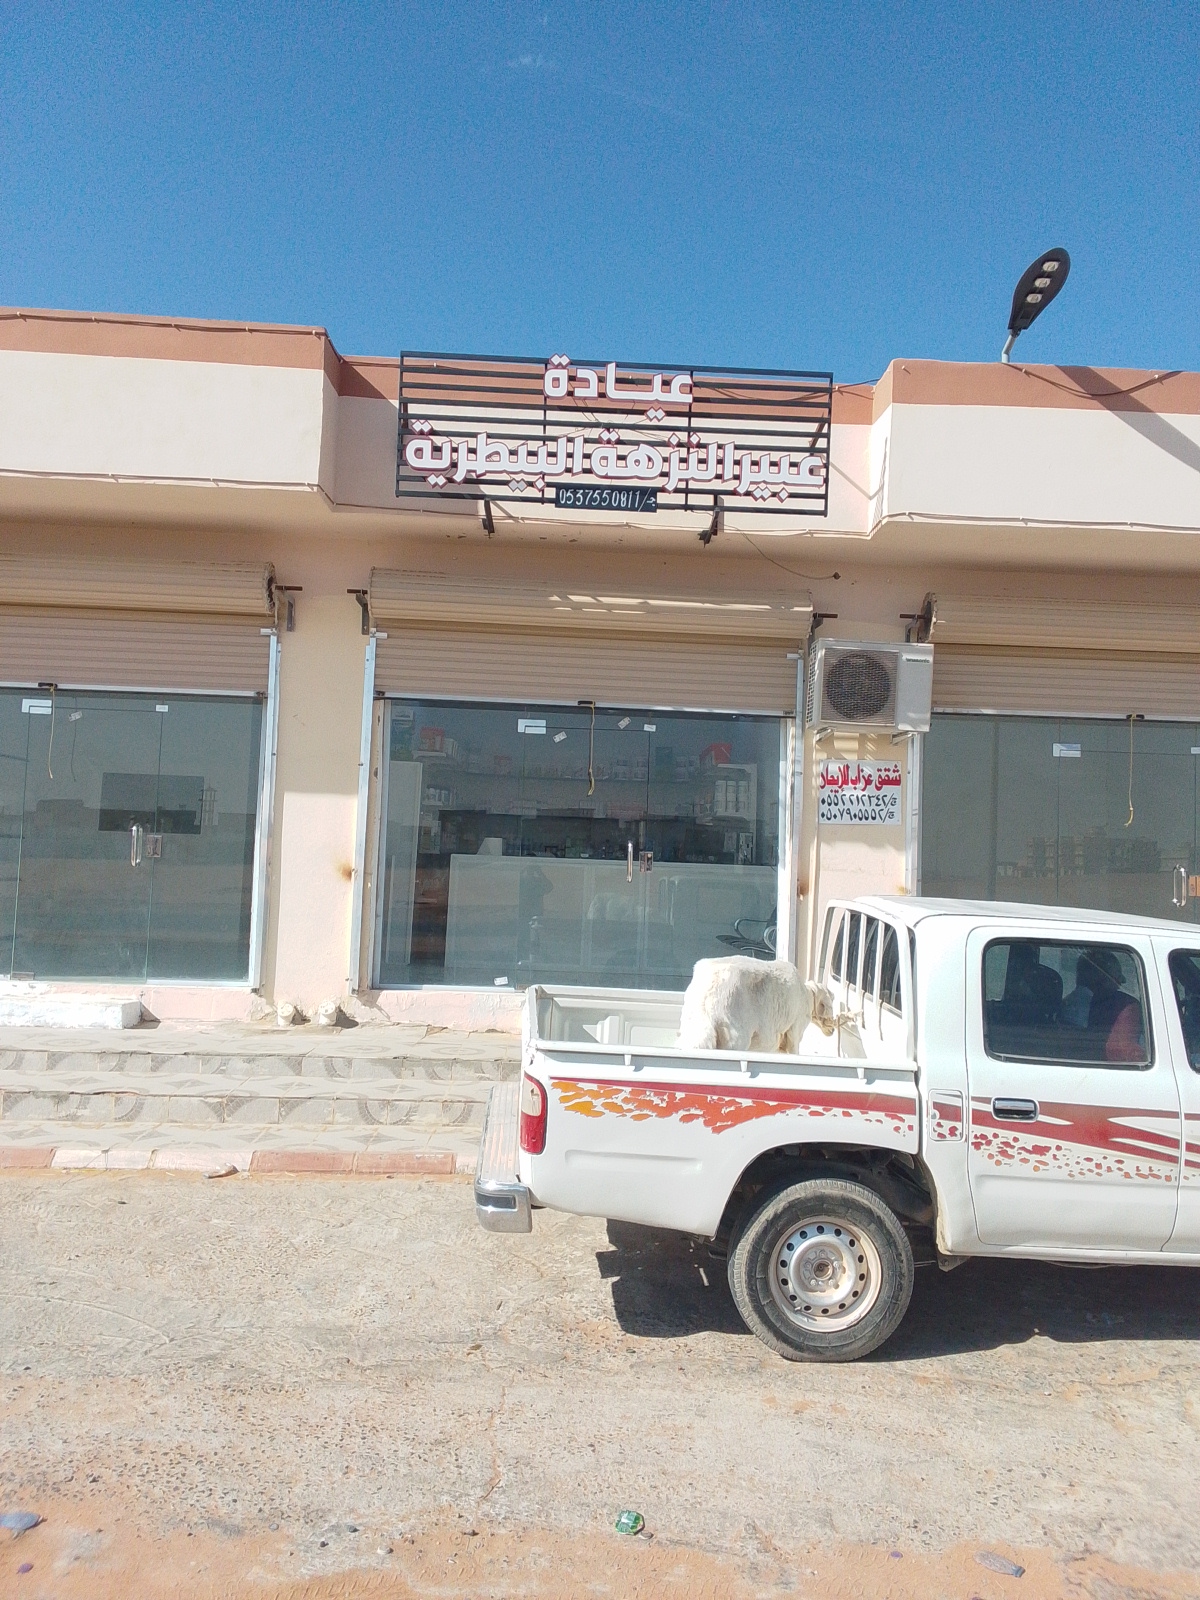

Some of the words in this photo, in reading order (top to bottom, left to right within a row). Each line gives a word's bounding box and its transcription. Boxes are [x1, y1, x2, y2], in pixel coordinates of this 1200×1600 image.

[543, 353, 694, 422] عيادة
[405, 419, 585, 492] البيطرية
[590, 428, 735, 494] النزهة
[733, 452, 825, 503] عبير
[850, 763, 873, 792] عزاب
[874, 763, 902, 791] شقق
